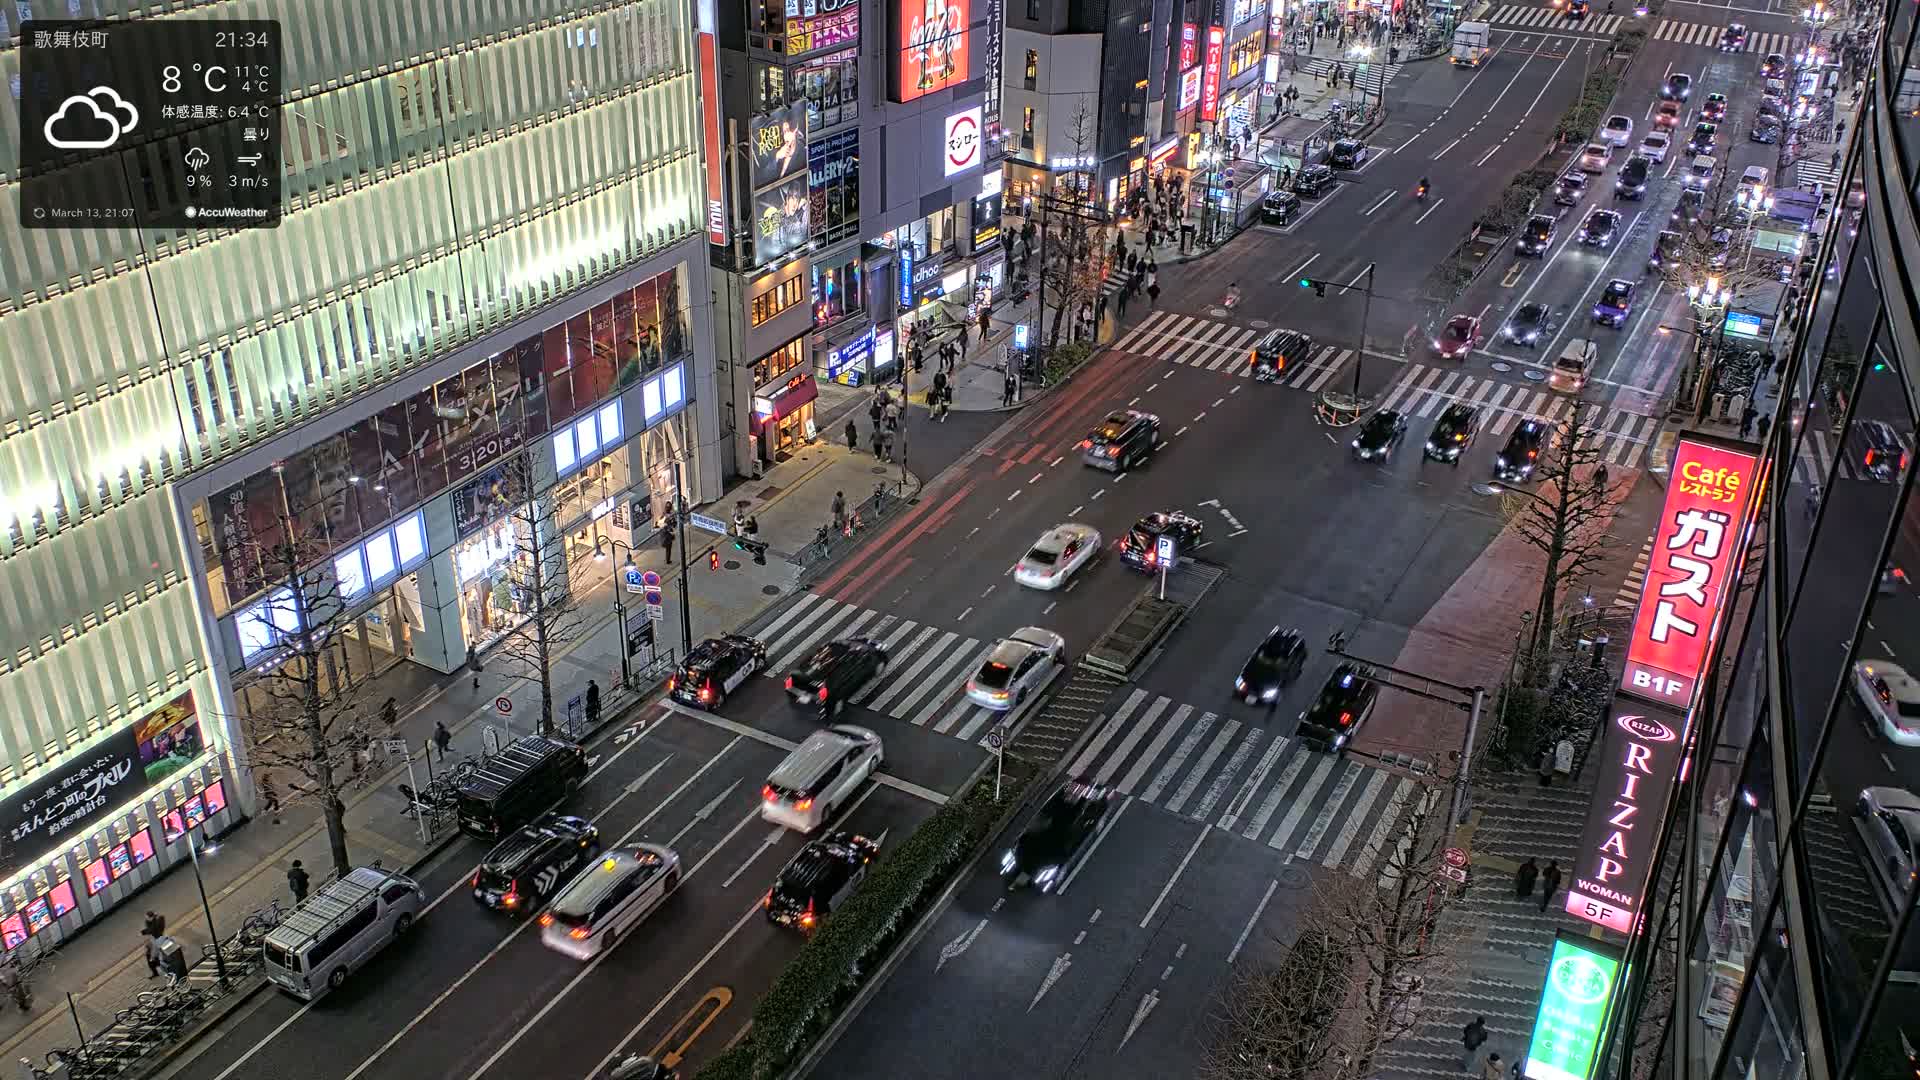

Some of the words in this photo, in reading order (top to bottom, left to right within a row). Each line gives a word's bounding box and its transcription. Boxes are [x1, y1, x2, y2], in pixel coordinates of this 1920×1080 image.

[710, 199, 723, 233] MUJI
[1681, 461, 1741, 491] Café
[1679, 480, 1736, 503] レストラン
[1649, 509, 1732, 645] ガスト
[1632, 671, 1684, 696] B1F
[1631, 720, 1663, 735] RIZAP
[19, 758, 132, 838] えんとつ町のプペル
[1595, 742, 1653, 883] RIZAP
[1578, 879, 1632, 906] WOMAN
[1584, 902, 1613, 921] 5F
